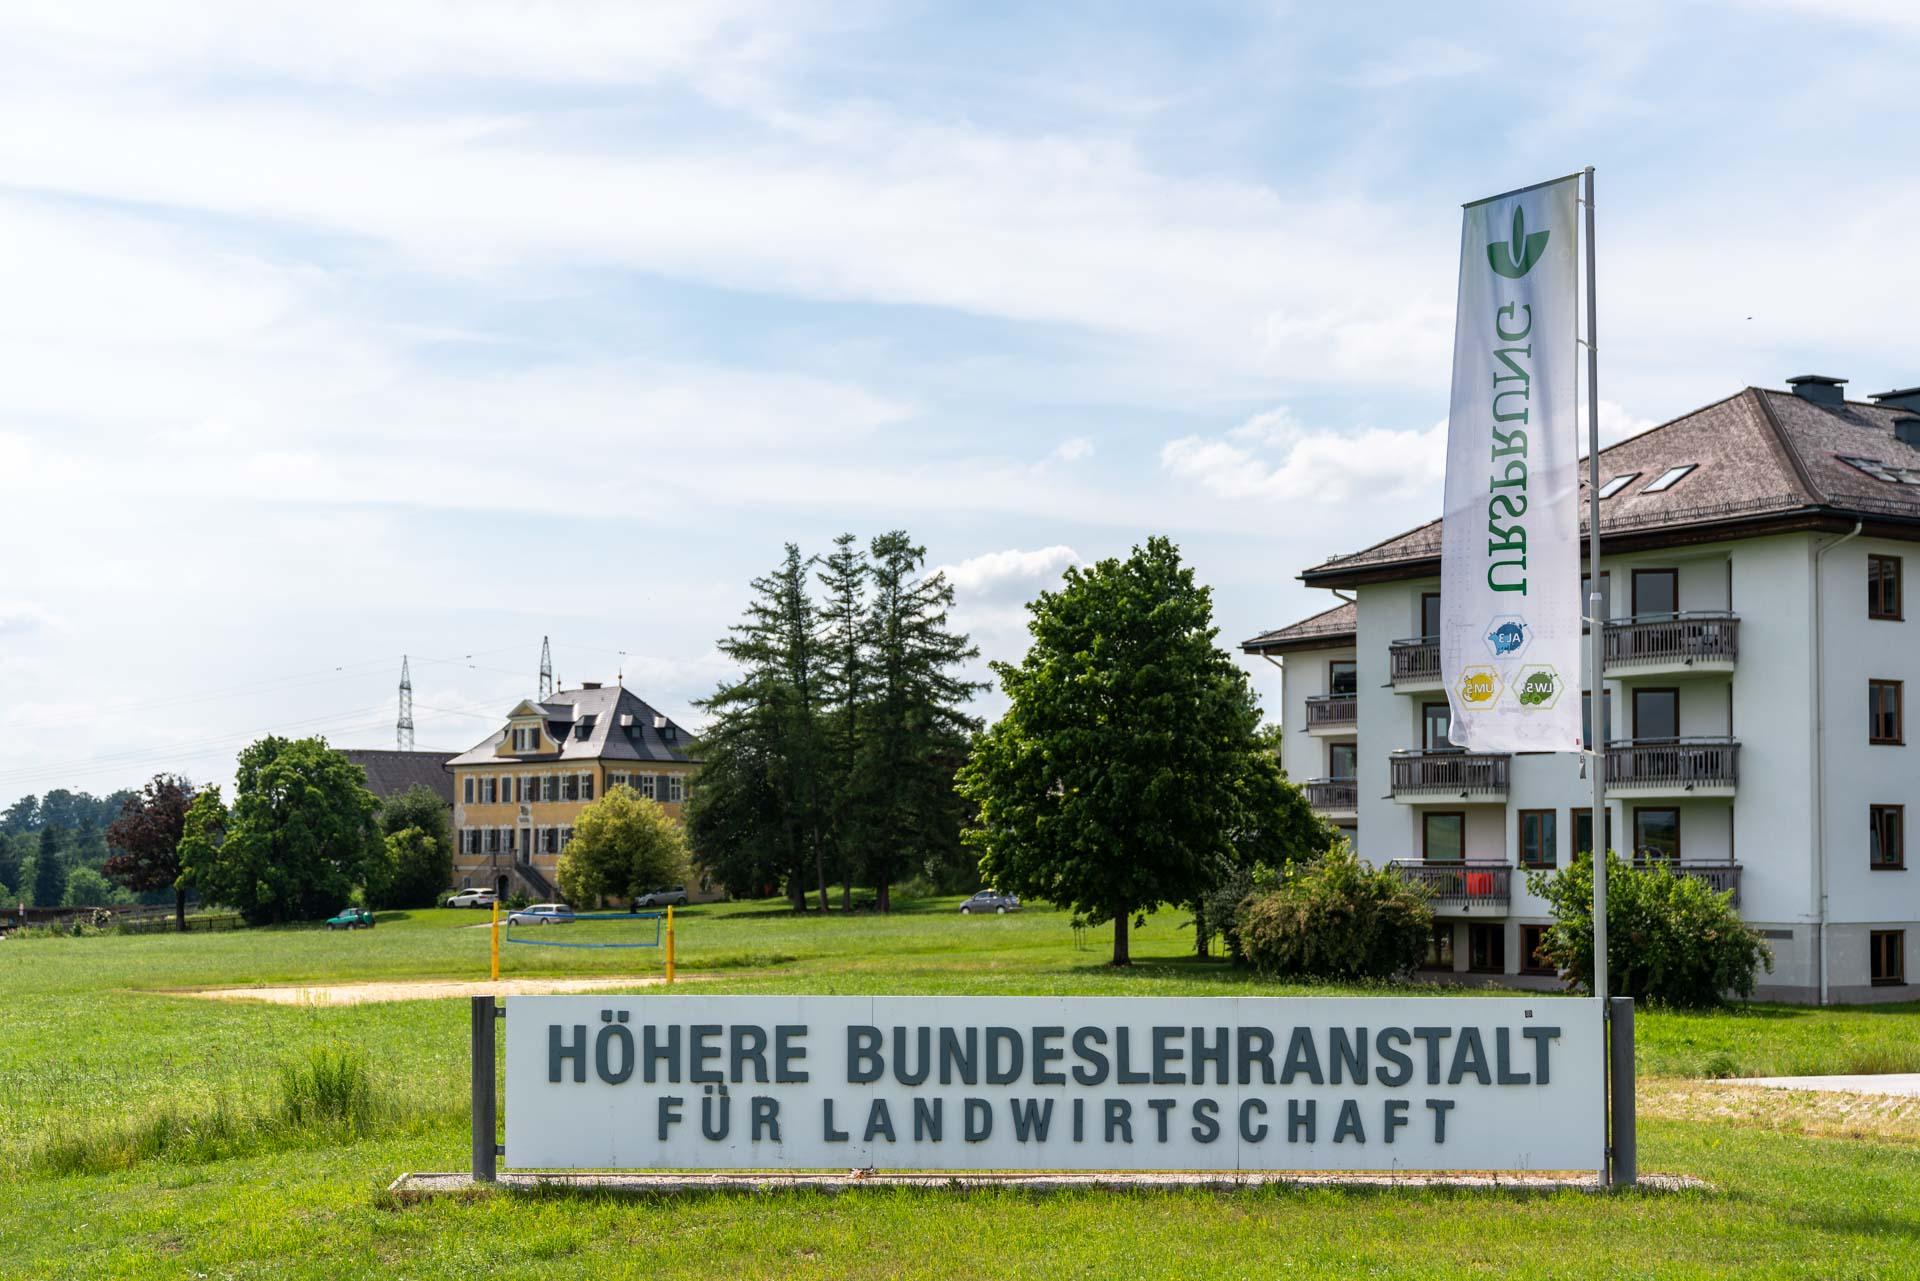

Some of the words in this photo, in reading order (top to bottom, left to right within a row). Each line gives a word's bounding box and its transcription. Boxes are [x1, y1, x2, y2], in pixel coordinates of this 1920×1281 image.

[548, 1010, 810, 1086] HÖHERE
[847, 1026, 1561, 1088] BUNDESLEHRANSTALT
[658, 1085, 782, 1144] FÜR
[823, 1098, 1455, 1145] LANDWIRTSCHAFT
